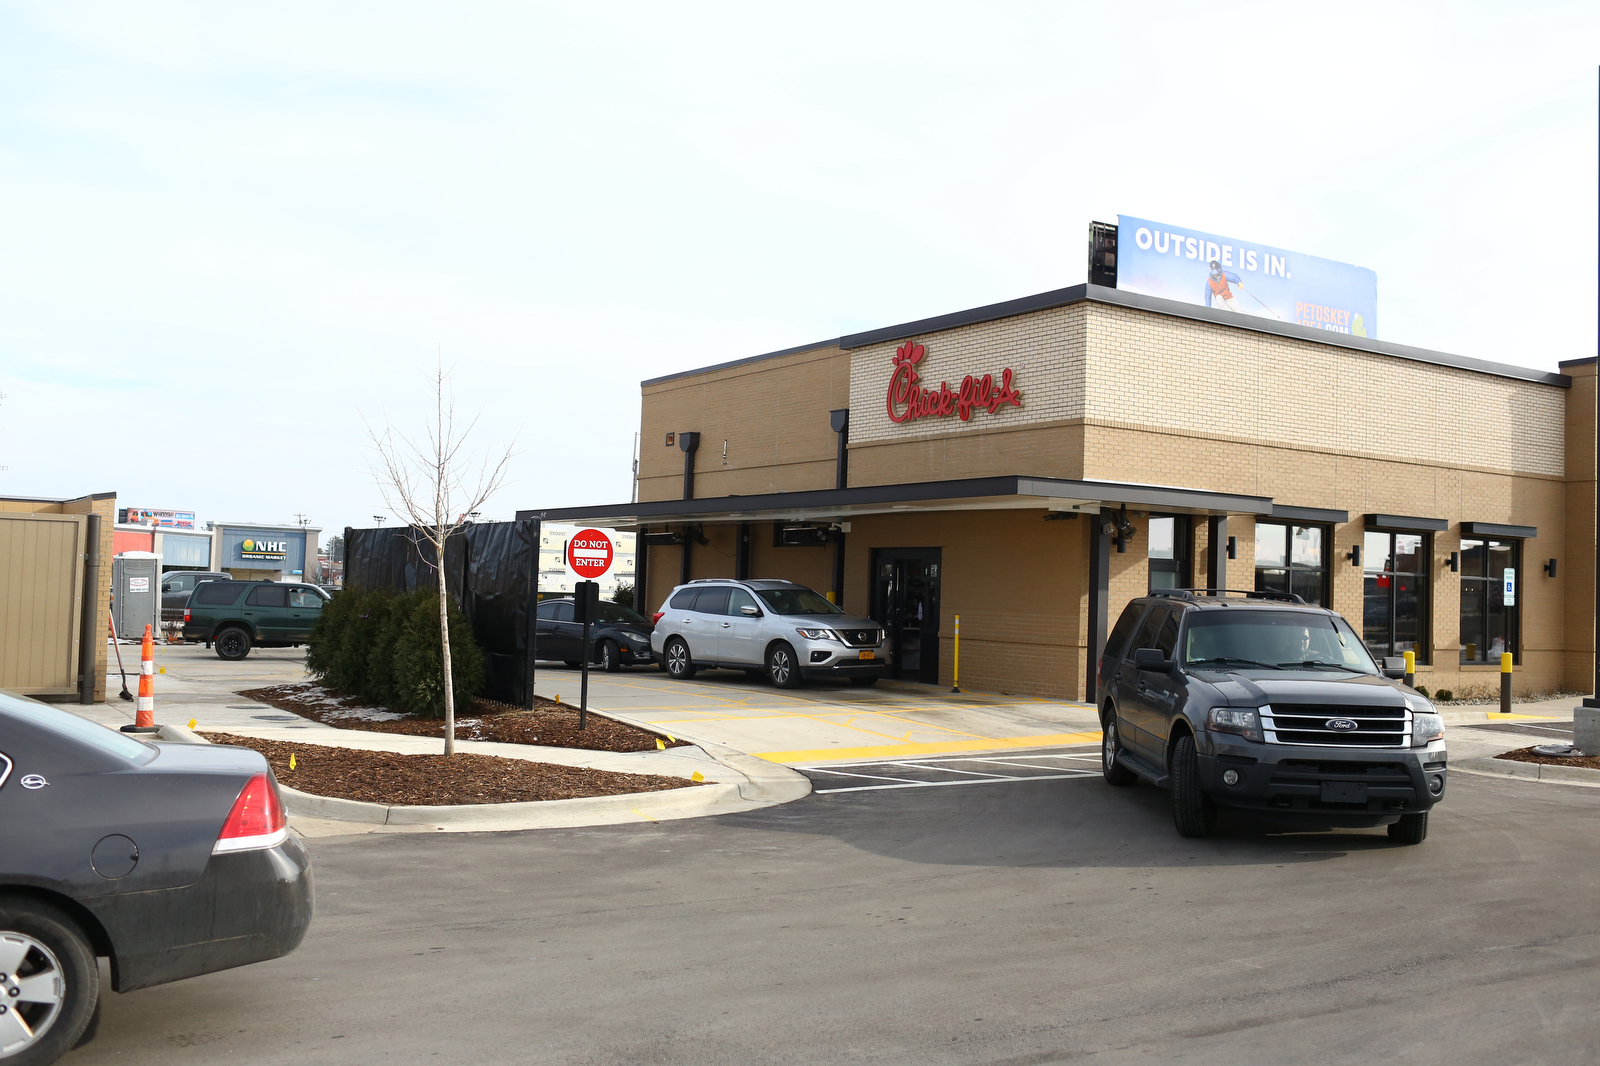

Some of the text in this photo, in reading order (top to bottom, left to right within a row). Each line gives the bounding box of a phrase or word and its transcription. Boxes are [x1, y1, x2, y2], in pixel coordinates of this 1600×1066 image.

[1135, 227, 1292, 279] OUTSIDE IS IN.
[1296, 301, 1350, 326] PETOSKEY
[887, 341, 1021, 423] Chick-fil-A
[255, 540, 287, 552] NHC
[573, 539, 608, 549] DO NOT
[575, 558, 605, 567] ENTER
[1333, 721, 1351, 729] Ford
